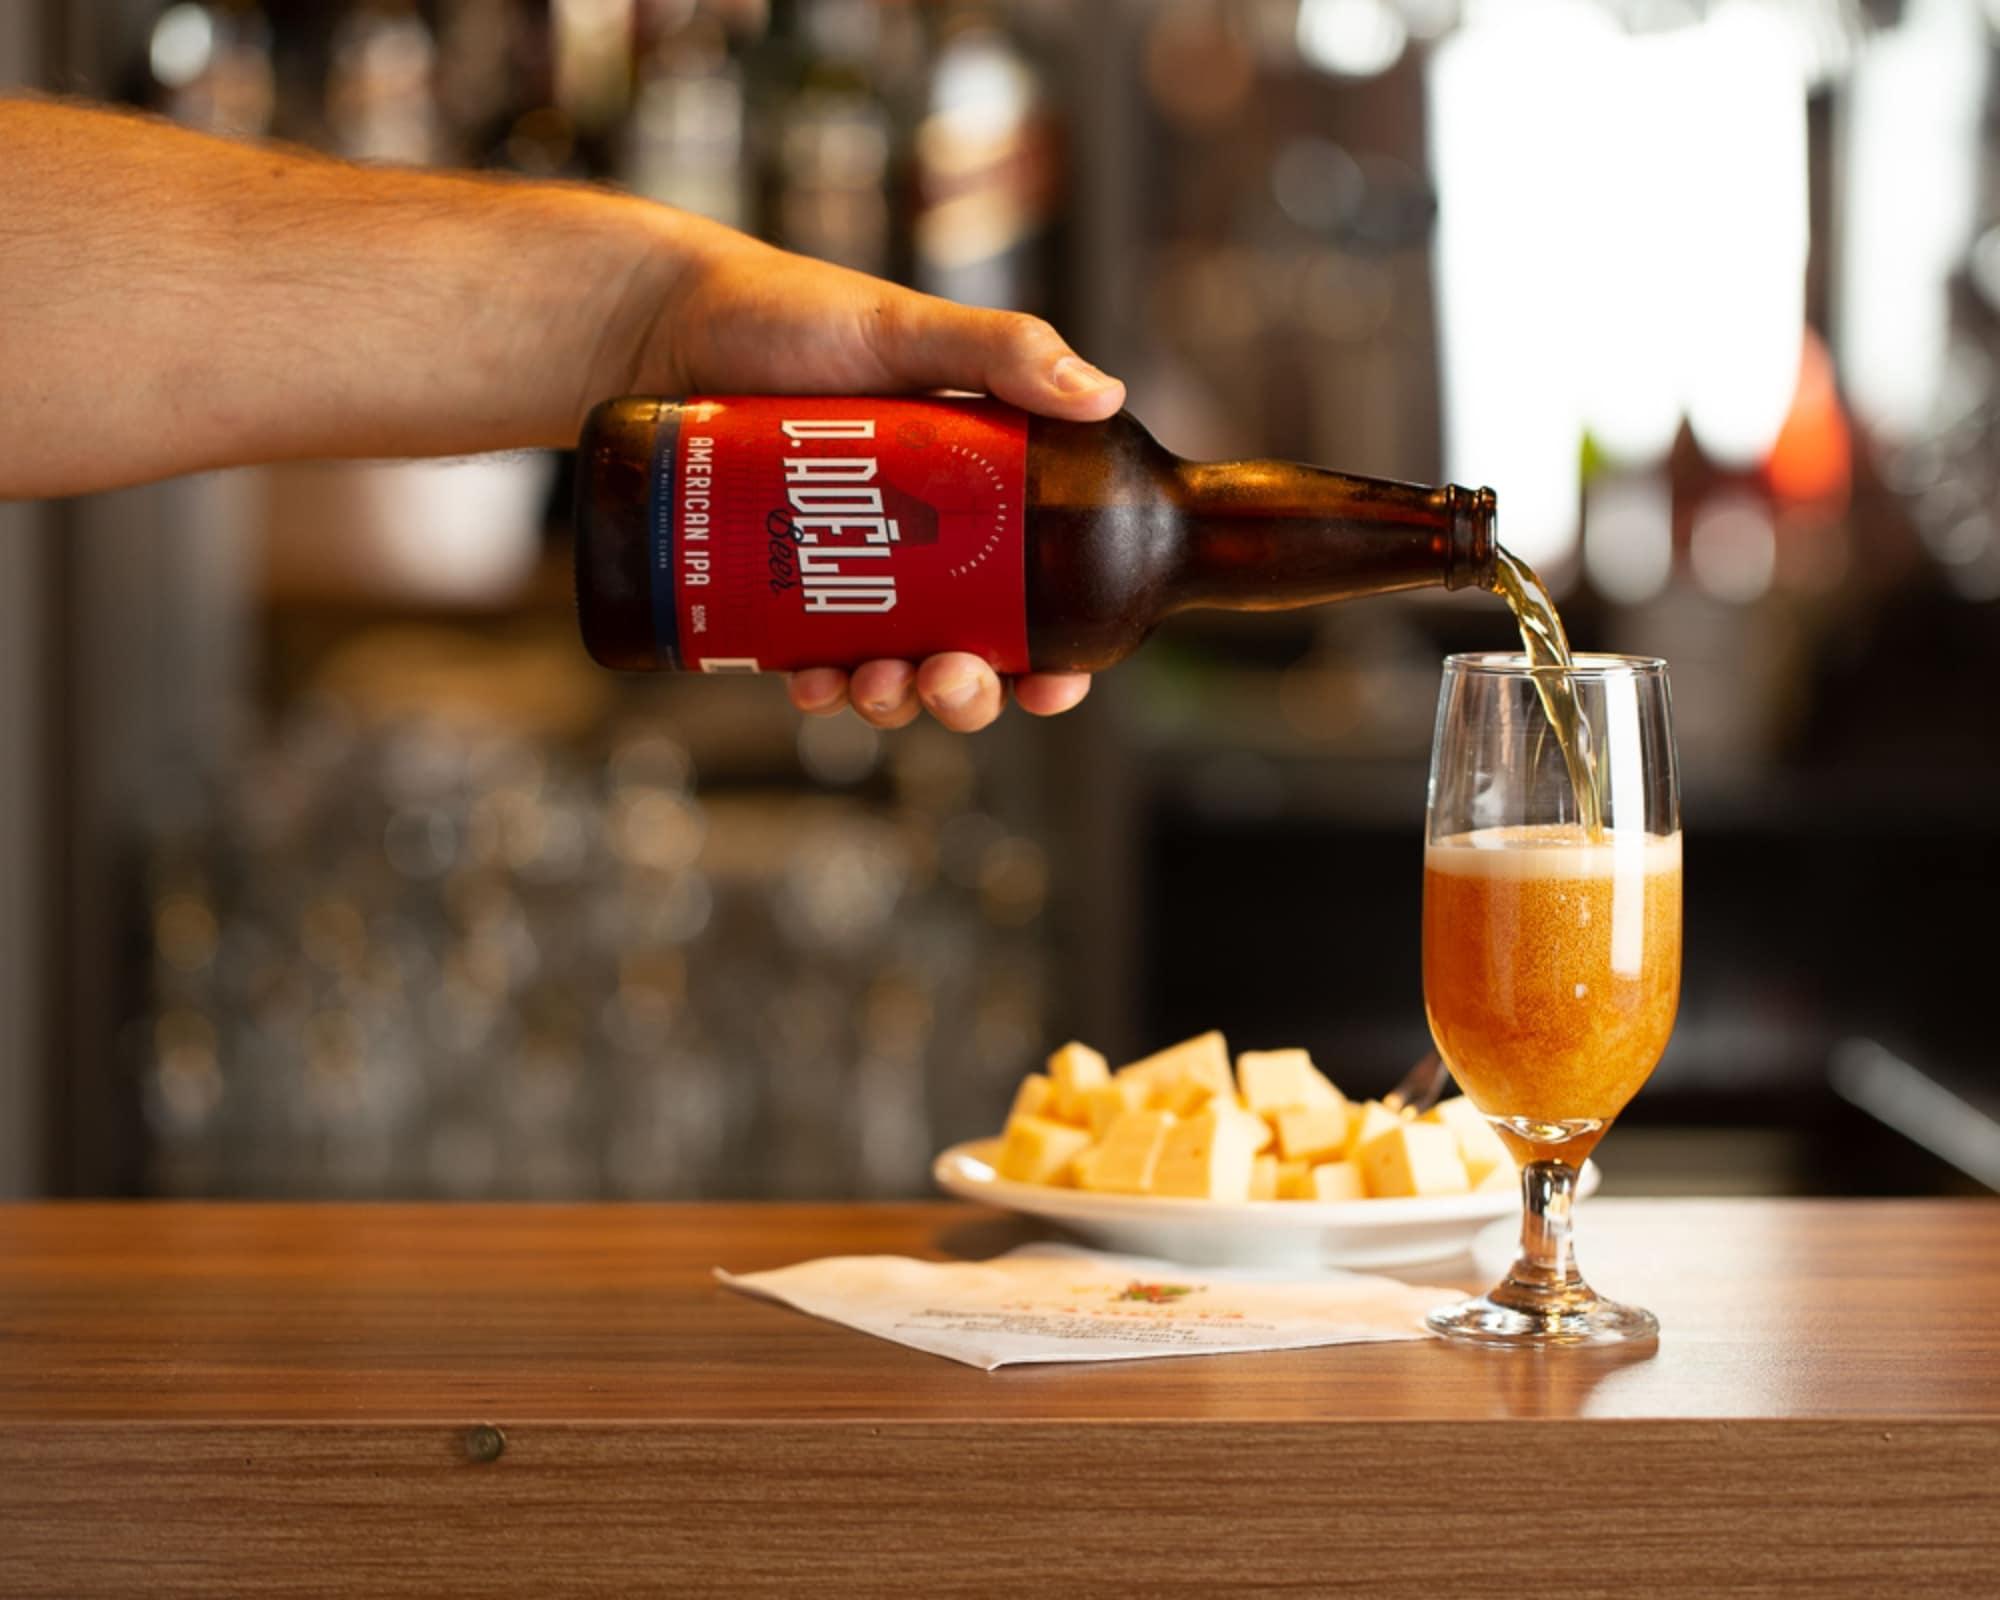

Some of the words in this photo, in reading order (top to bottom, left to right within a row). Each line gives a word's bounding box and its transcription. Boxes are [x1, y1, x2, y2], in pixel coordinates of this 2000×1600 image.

[781, 420, 876, 448] D.
[684, 437, 715, 541] AMERICAN
[684, 551, 711, 586] IPA
[767, 508, 805, 596] Beer
[783, 457, 901, 613] ADÉLIA
